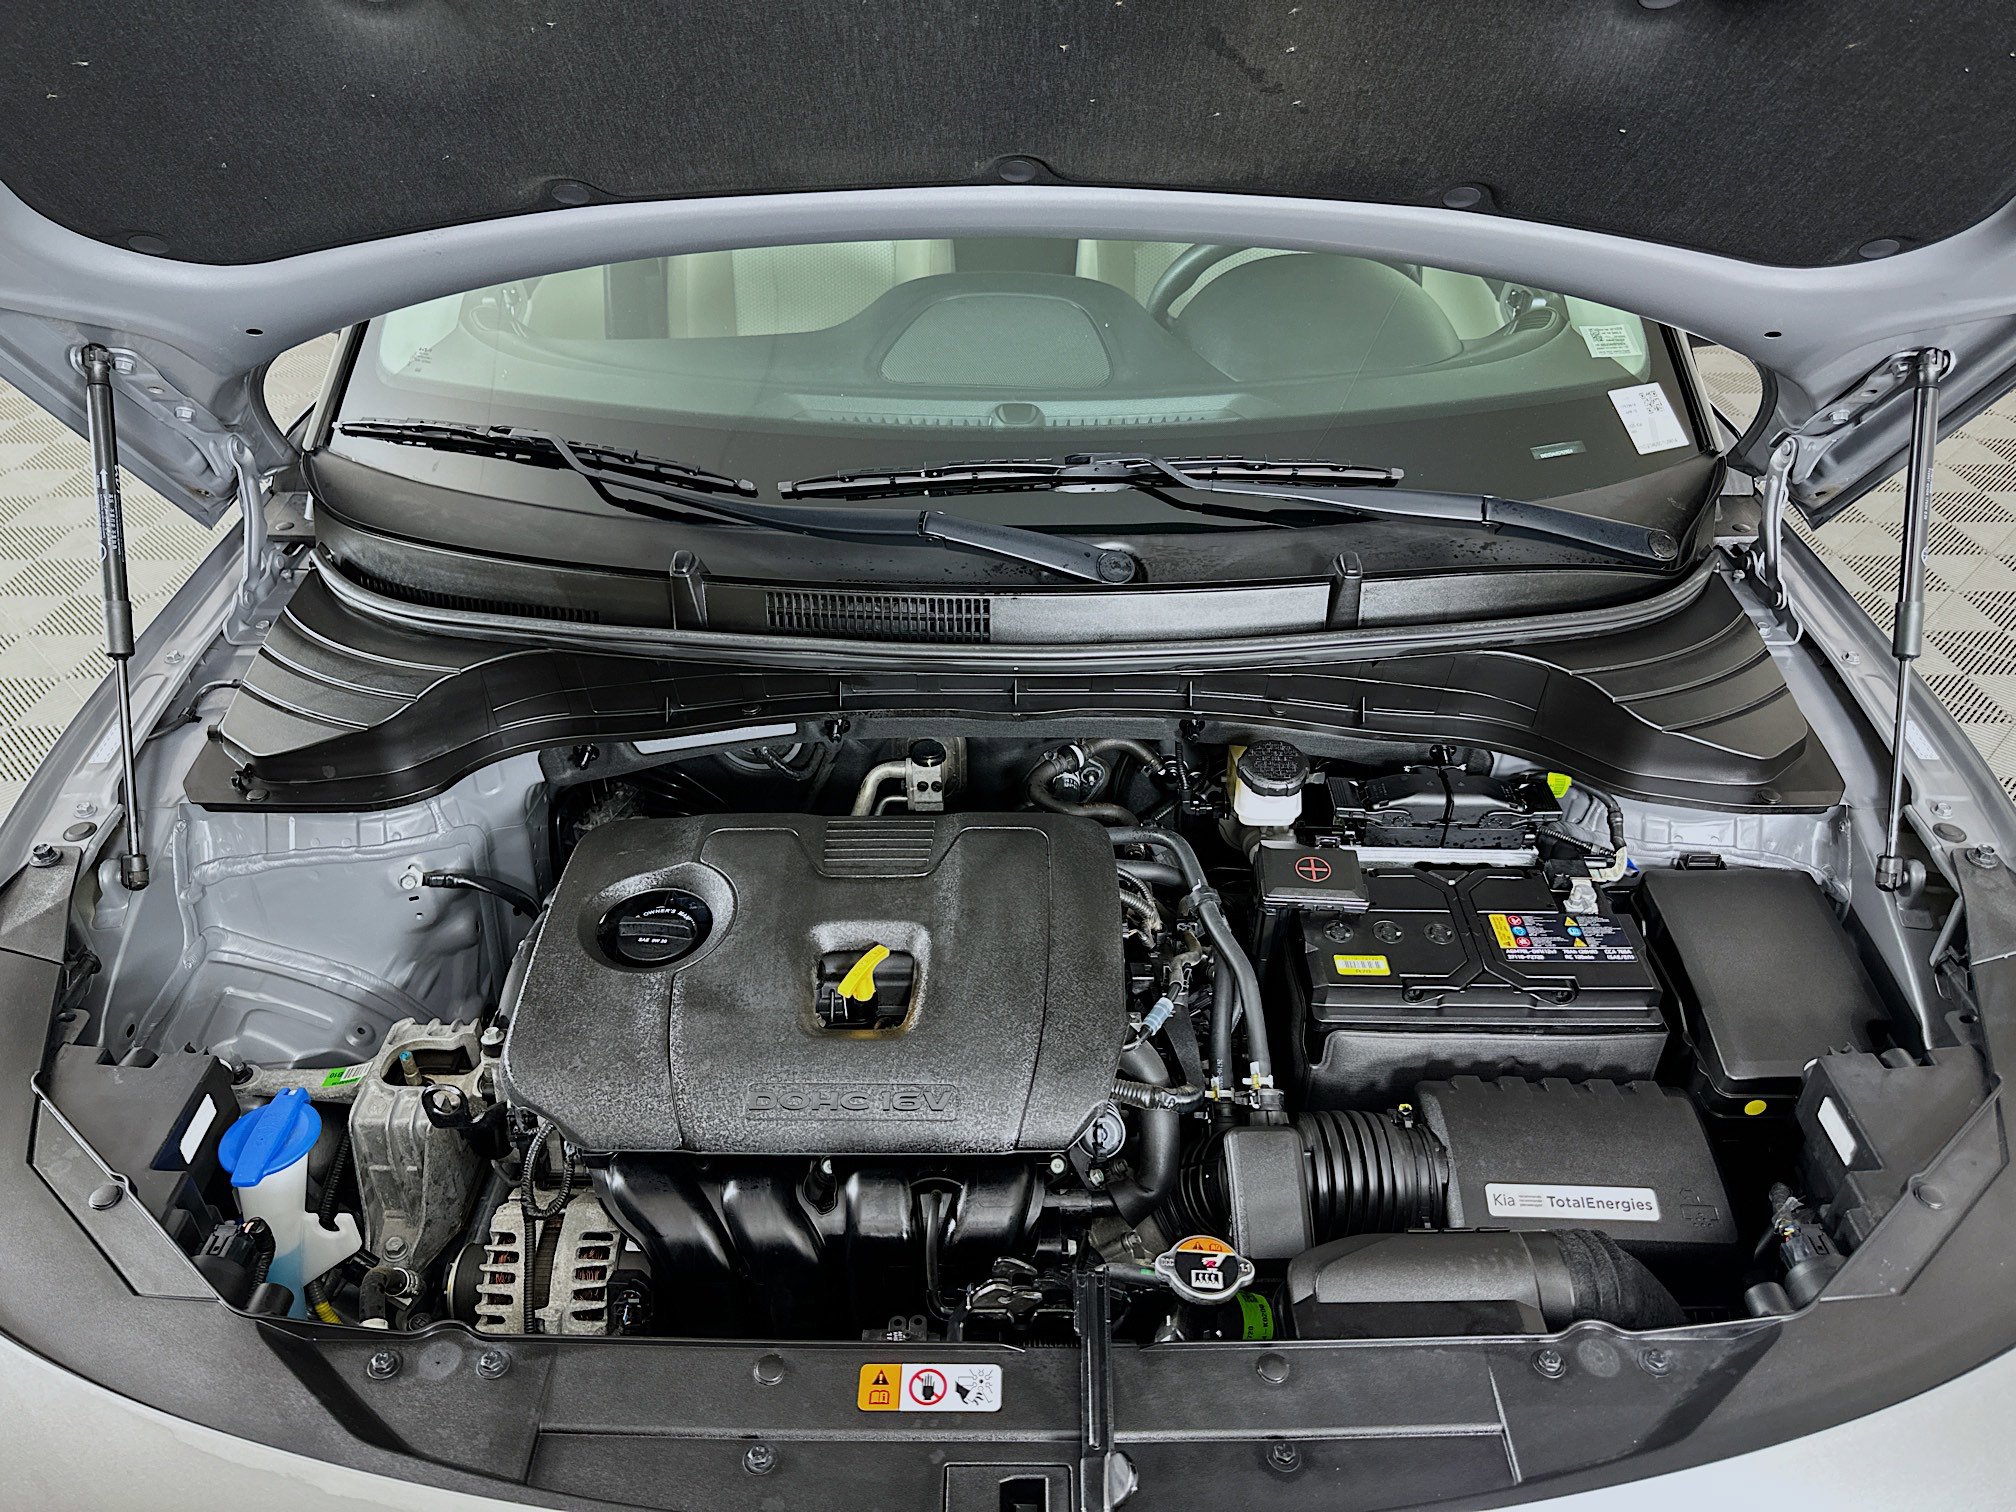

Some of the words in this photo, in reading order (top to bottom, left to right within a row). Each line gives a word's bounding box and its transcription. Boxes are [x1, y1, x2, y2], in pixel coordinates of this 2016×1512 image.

[643, 908, 676, 917] OWNER'S
[749, 1091, 870, 1111] DOHC
[881, 1091, 954, 1111] 16V
[1492, 1193, 1515, 1207] Kia
[1547, 1196, 1653, 1212] TotalEnergies
[1239, 1263, 1251, 1273] 1.1
